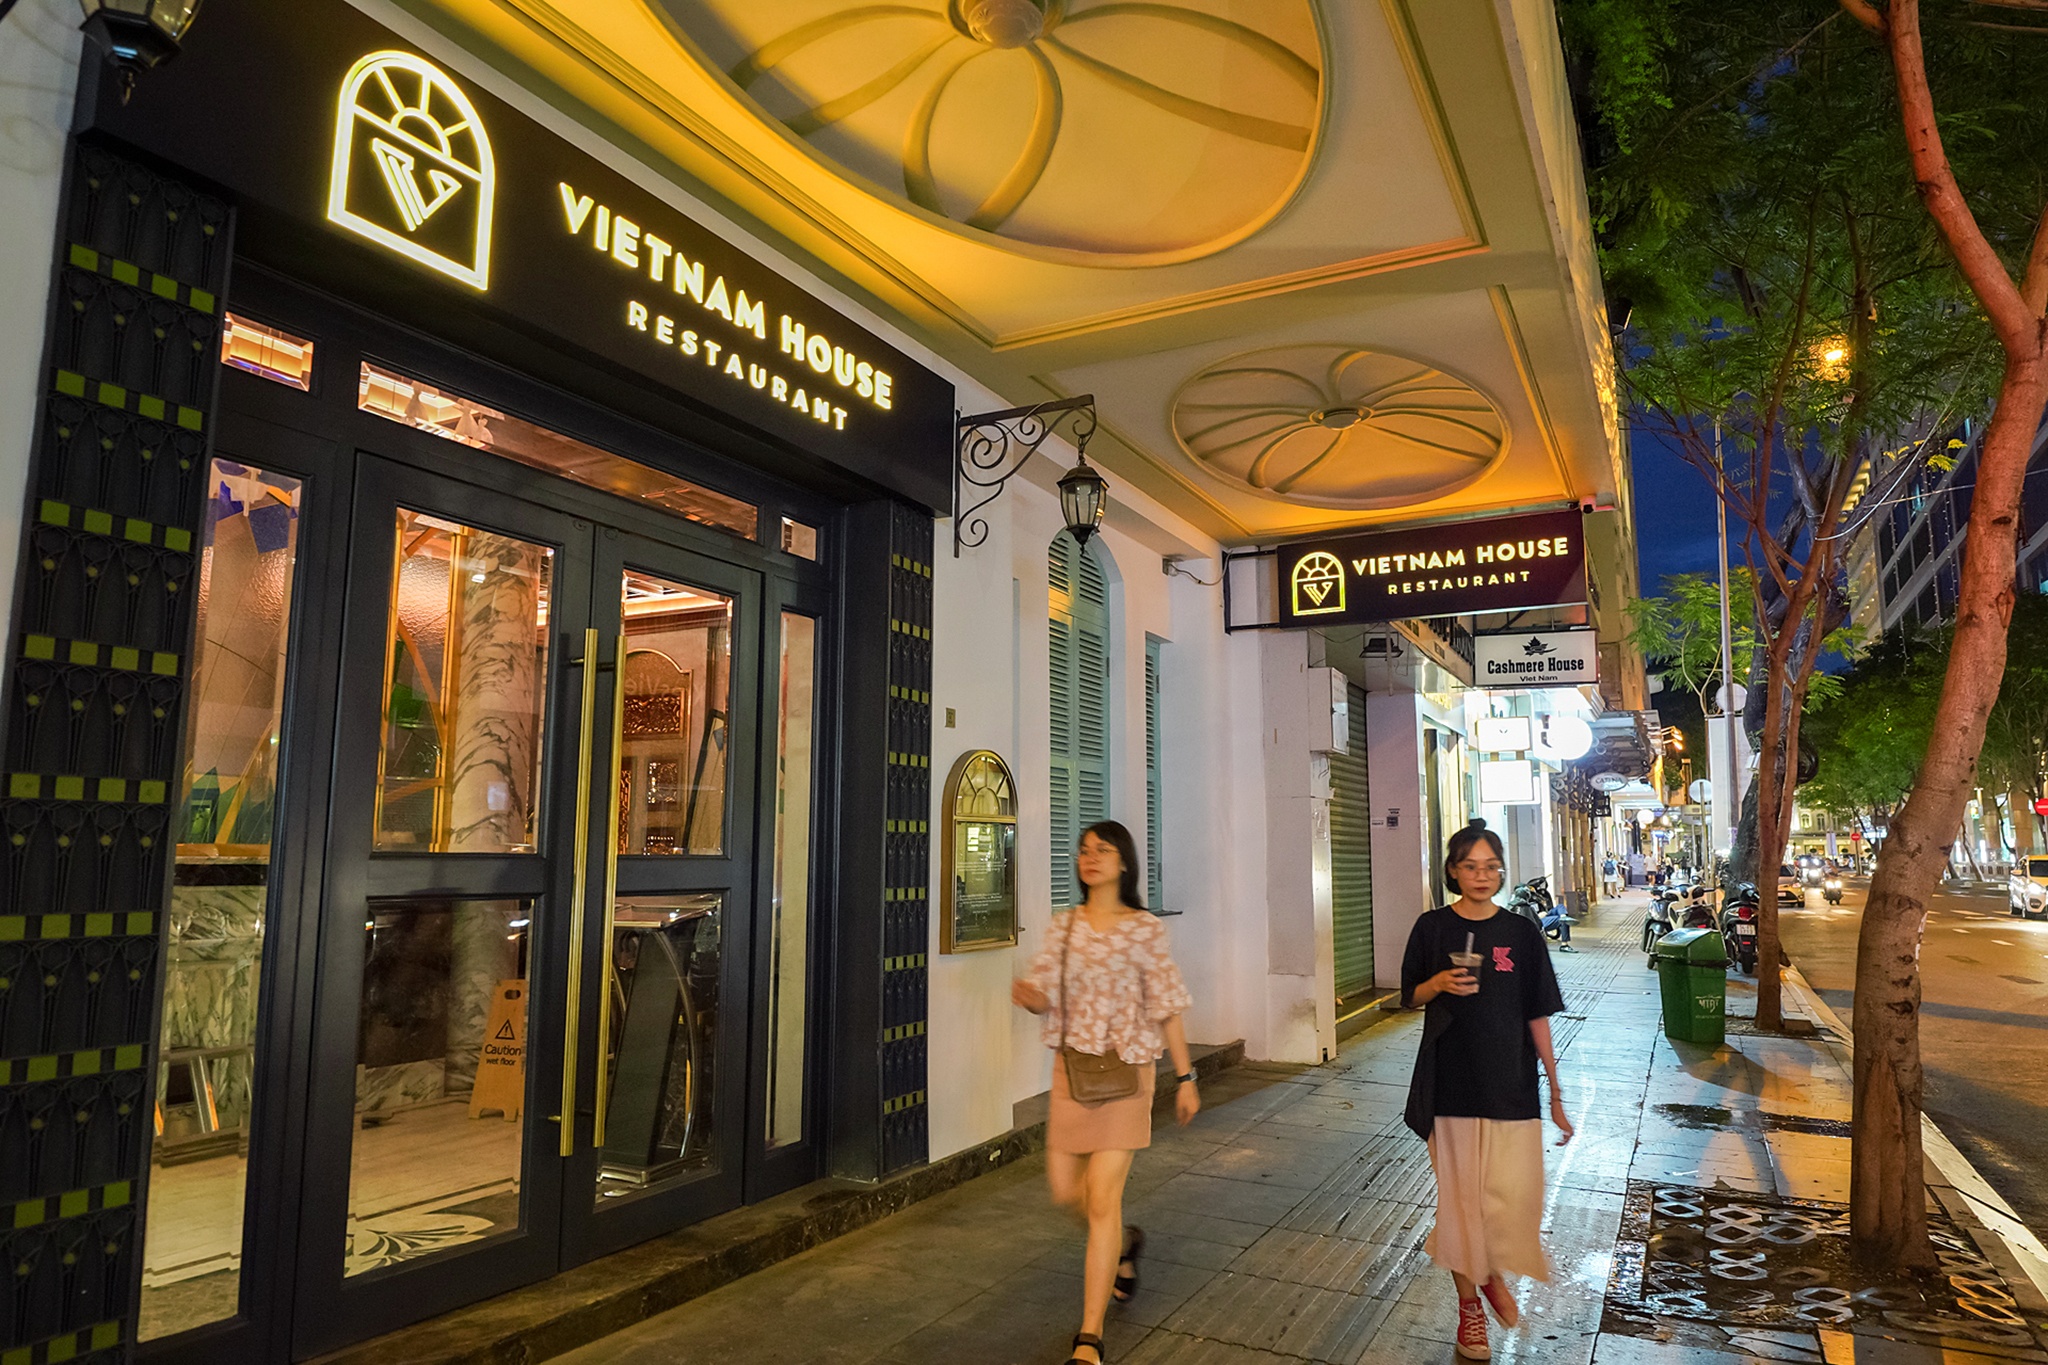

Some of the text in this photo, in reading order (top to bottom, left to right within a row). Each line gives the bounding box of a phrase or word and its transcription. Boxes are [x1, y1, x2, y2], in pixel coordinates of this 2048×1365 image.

[559, 182, 893, 410] VIETNAM HOUSE
[627, 300, 848, 431] RESTAURANT
[1352, 537, 1569, 577] VIETNAM HOUSE
[1388, 571, 1531, 595] RESTAURANT
[1487, 657, 1585, 675] Cashmere House
[484, 1043, 522, 1056] Caution
[486, 1057, 516, 1066] wet floor
